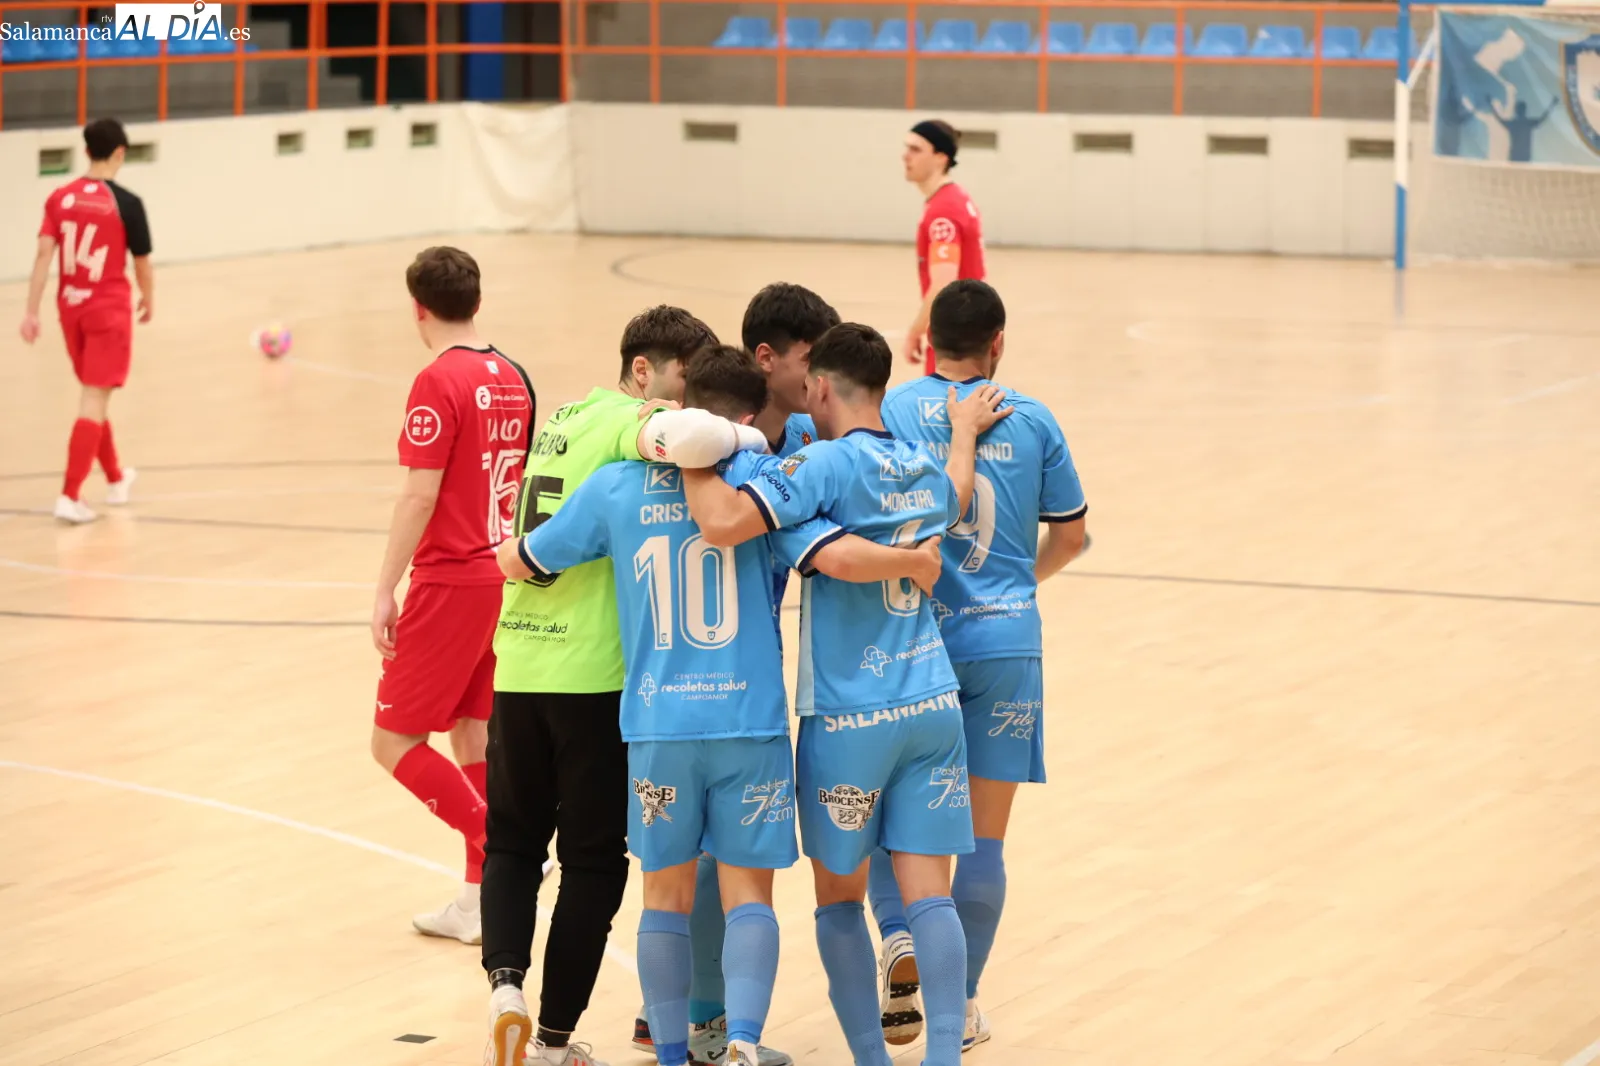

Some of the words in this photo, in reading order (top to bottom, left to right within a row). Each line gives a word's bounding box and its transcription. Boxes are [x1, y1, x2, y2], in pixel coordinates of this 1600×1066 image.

[60, 220, 109, 282] 14
[946, 471, 996, 574] 9
[633, 533, 740, 650] 10
[960, 602, 1009, 615] recoletas
[1011, 599, 1032, 610] salud
[542, 622, 569, 634] salud
[661, 681, 715, 692] recoletas
[717, 679, 748, 691] salud
[681, 693, 728, 701] CAMPOAMOR
[838, 809, 858, 825] 22
